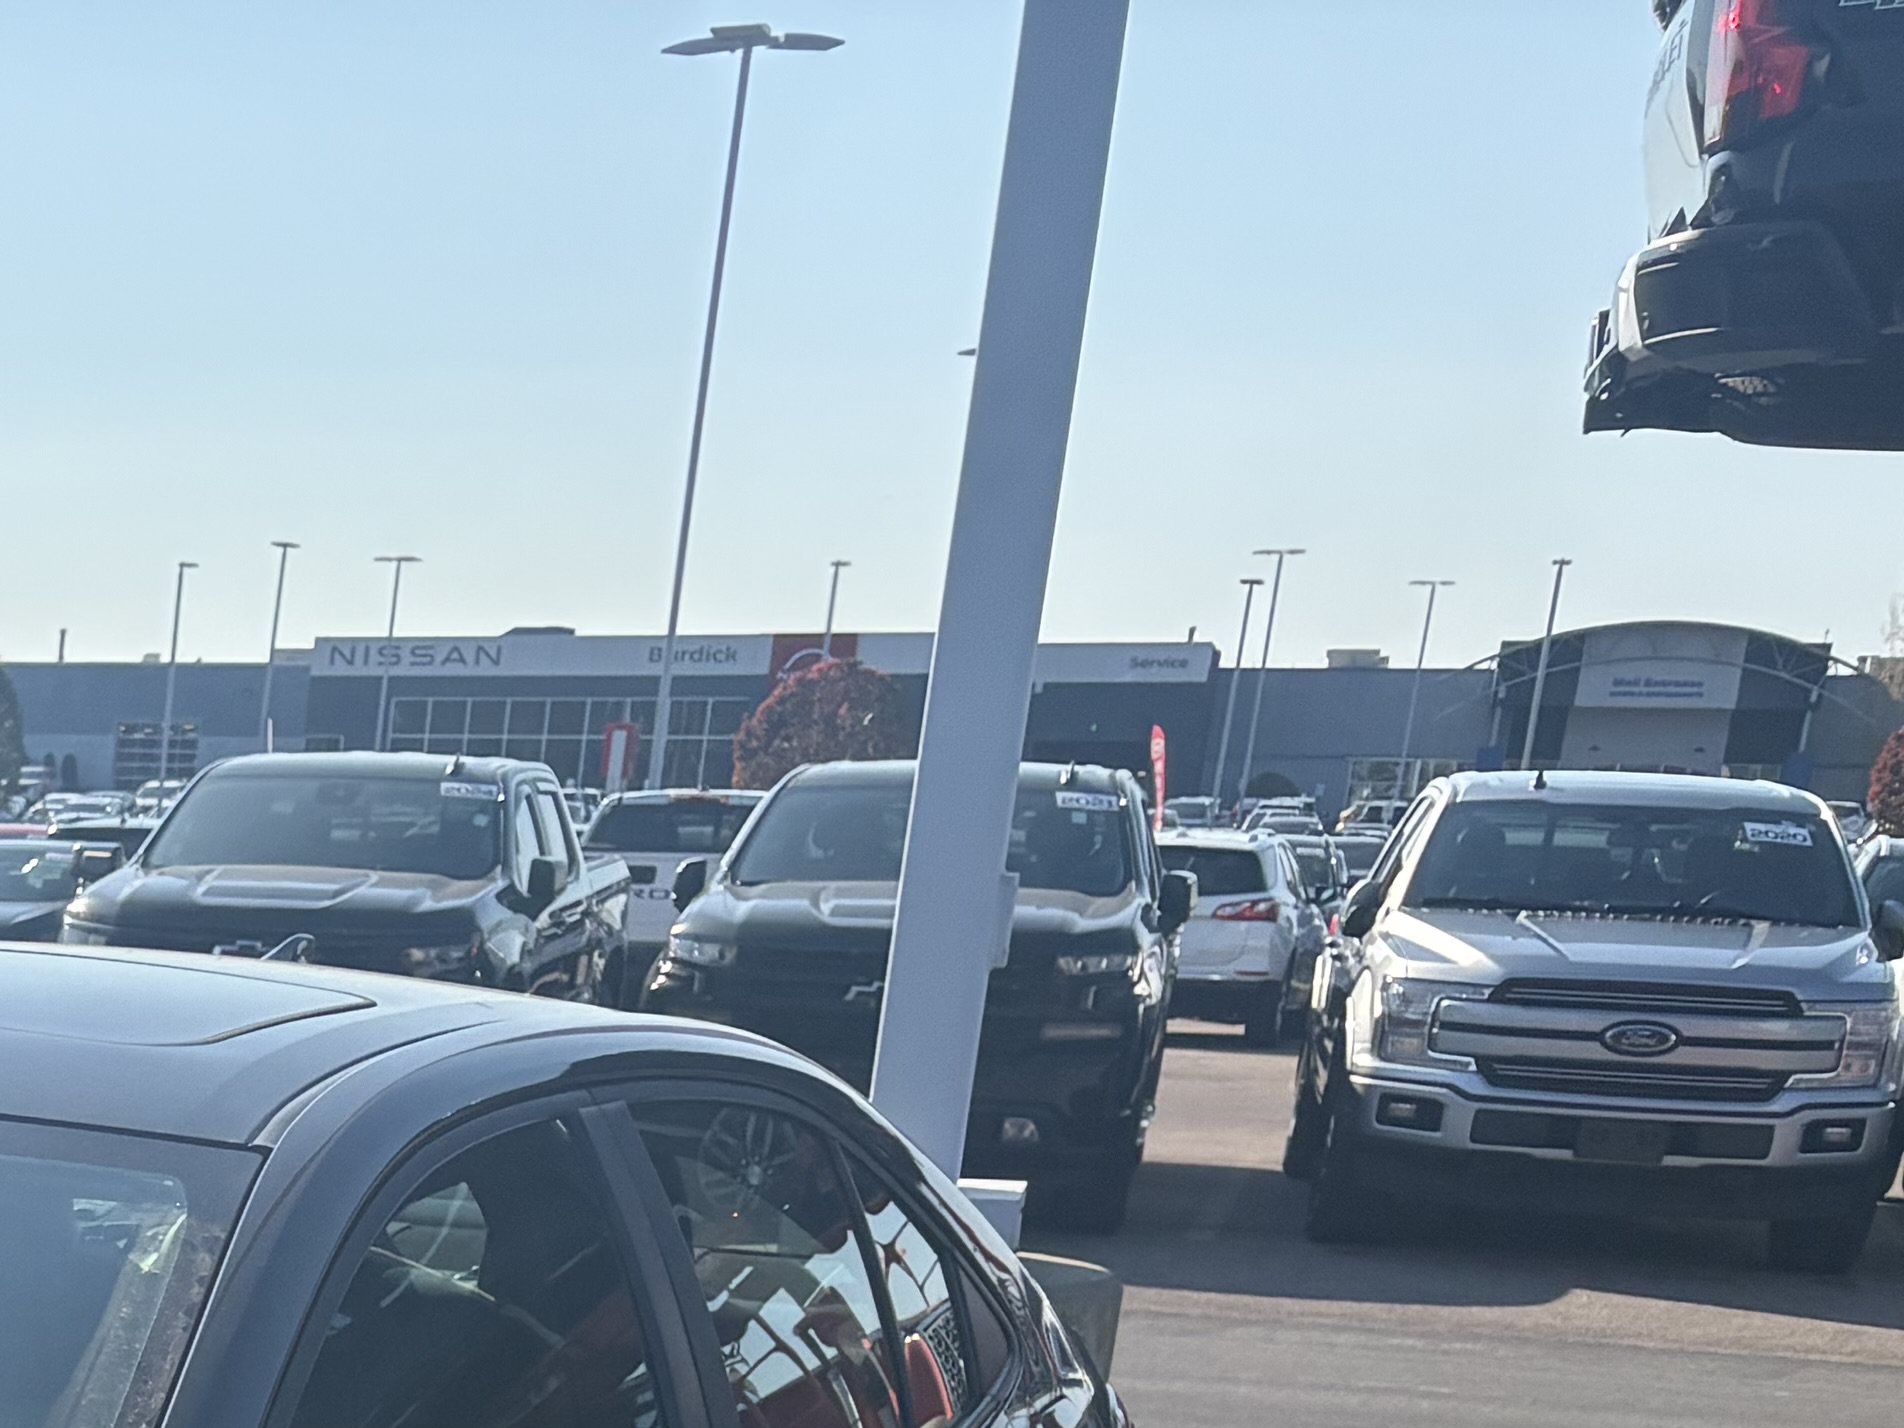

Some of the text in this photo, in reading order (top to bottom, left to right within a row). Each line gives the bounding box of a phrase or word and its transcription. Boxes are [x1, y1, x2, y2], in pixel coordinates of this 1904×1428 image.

[329, 644, 504, 668] NISSAN
[1129, 655, 1189, 670] Service
[1749, 828, 1808, 843] 2020
